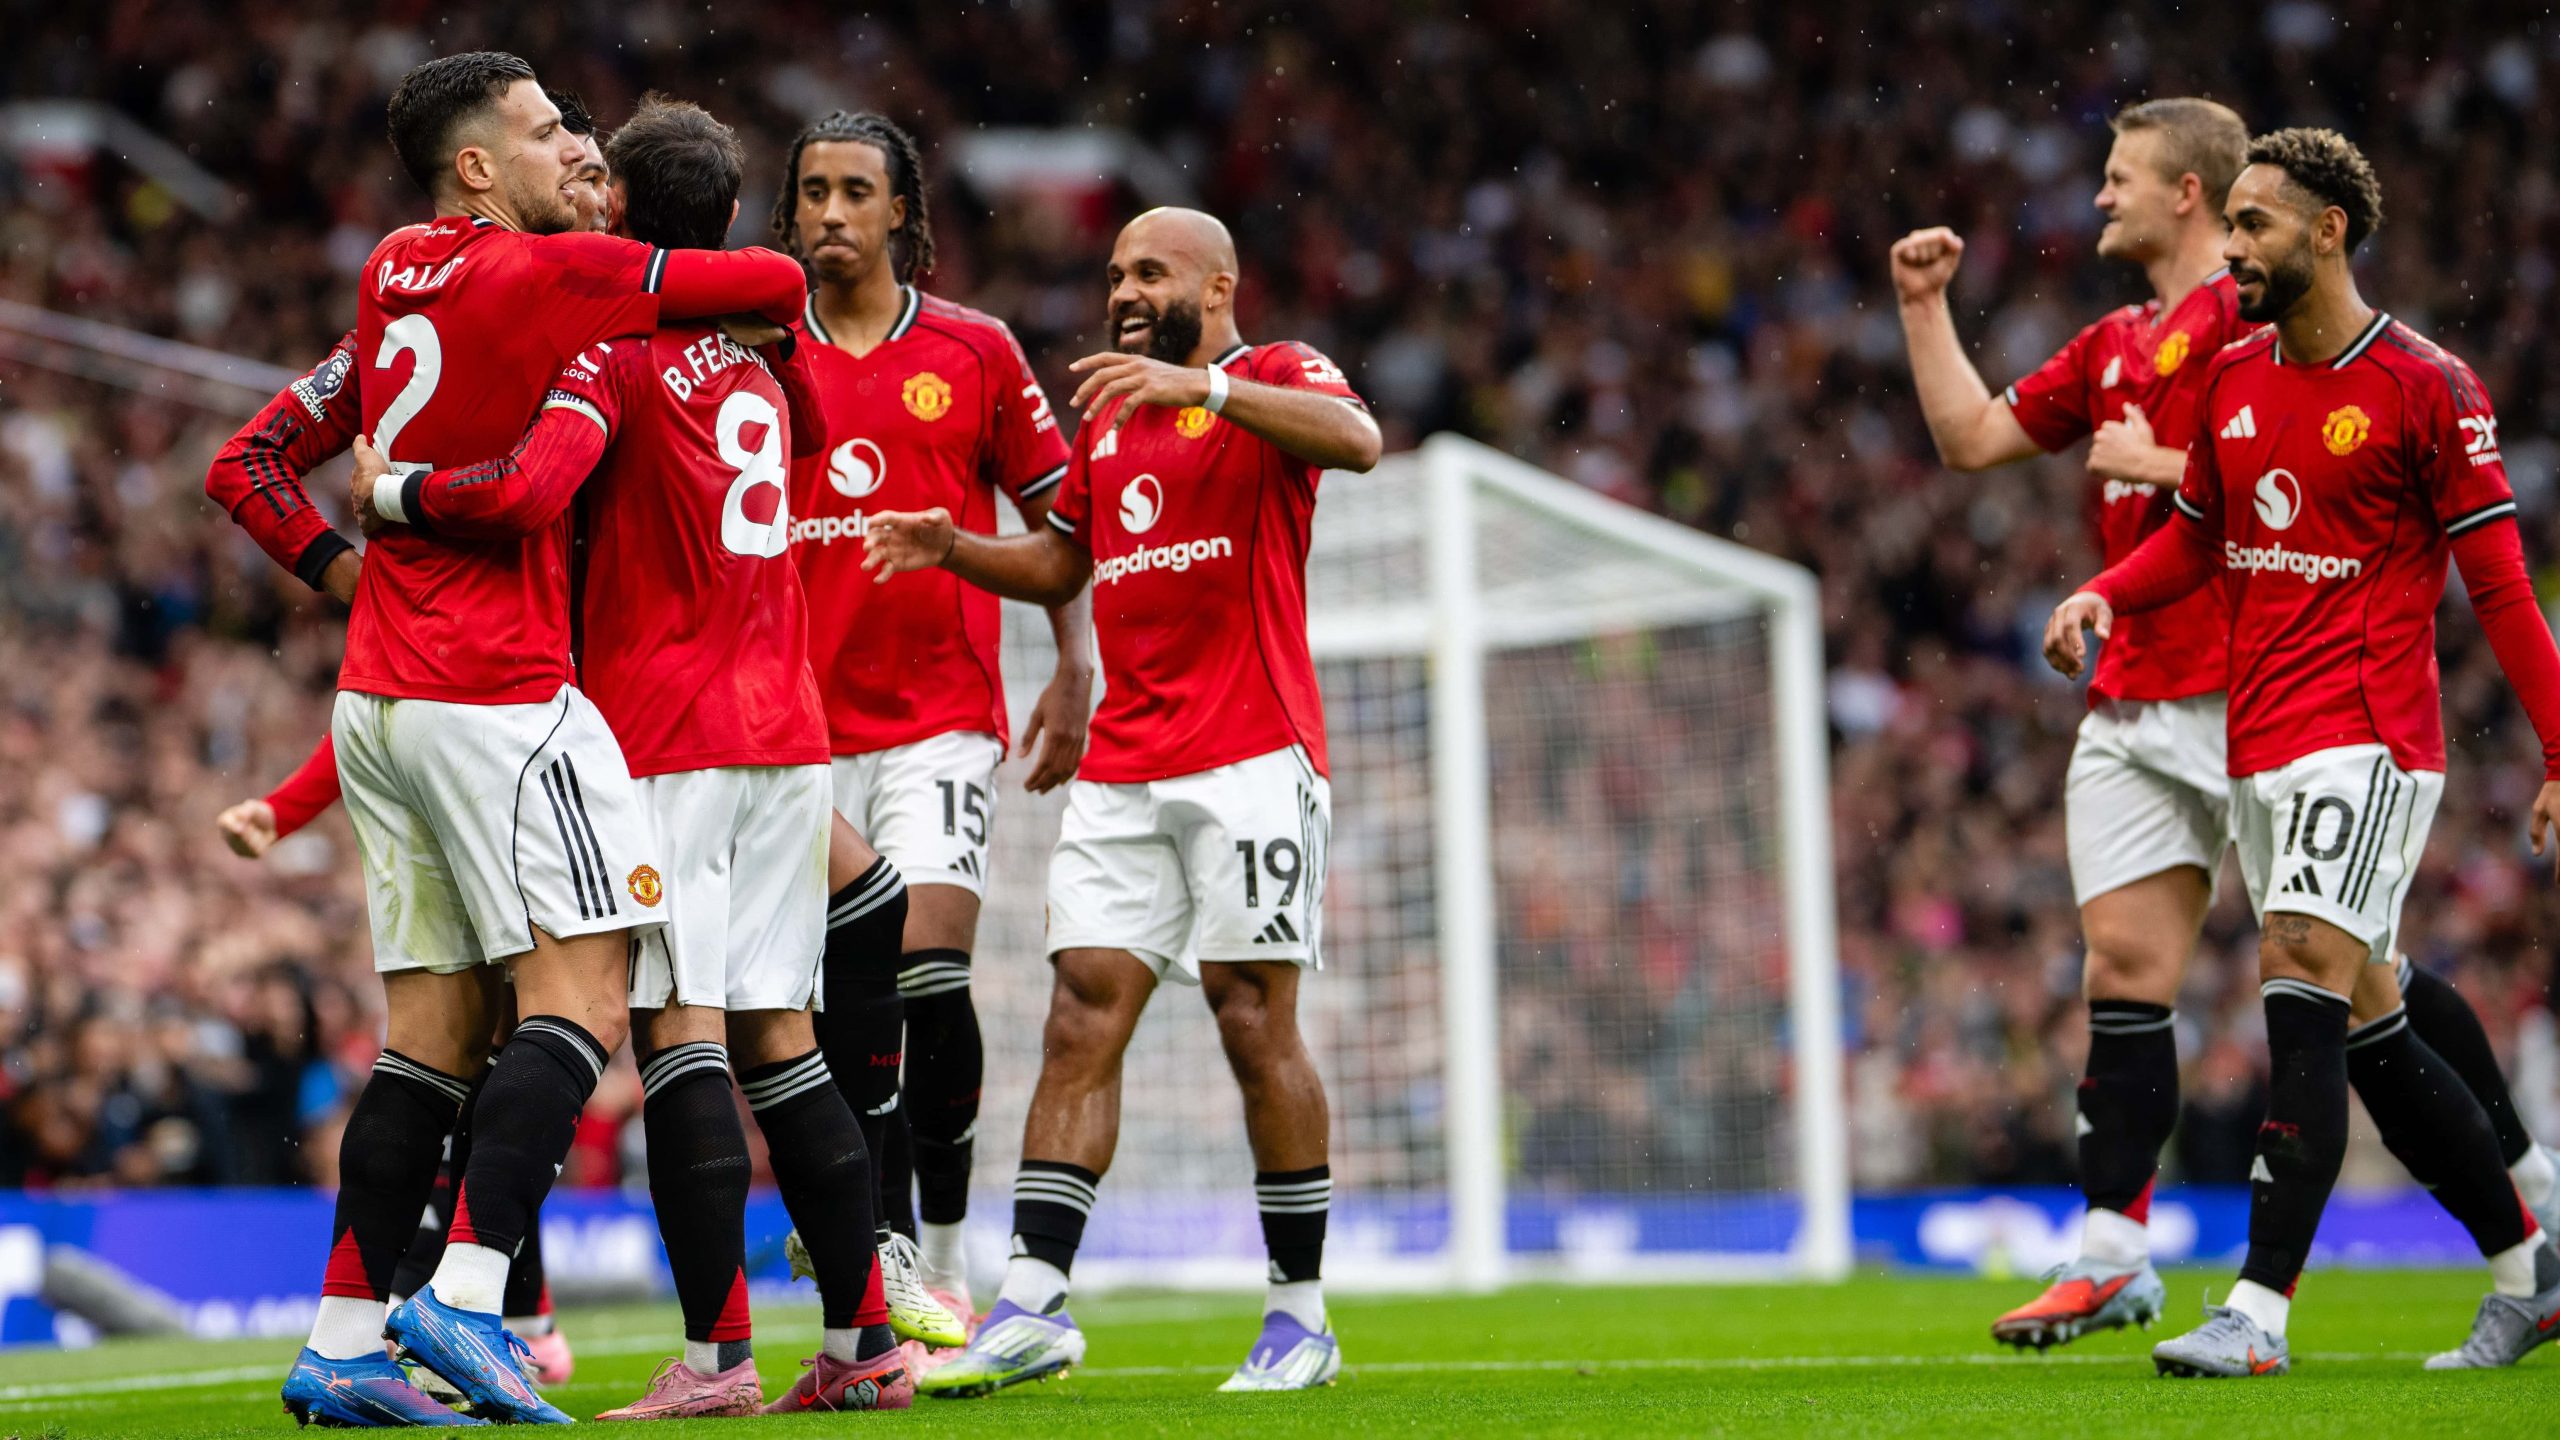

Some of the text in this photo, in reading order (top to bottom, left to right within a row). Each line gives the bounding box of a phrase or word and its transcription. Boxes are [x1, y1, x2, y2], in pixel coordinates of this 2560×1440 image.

[379, 257, 465, 296] DALOT
[297, 389, 325, 423] racism
[374, 313, 443, 476] 2
[715, 390, 790, 559] 8
[936, 780, 986, 848] 15
[2283, 792, 2355, 862] 10
[1236, 838, 1302, 908] 19
